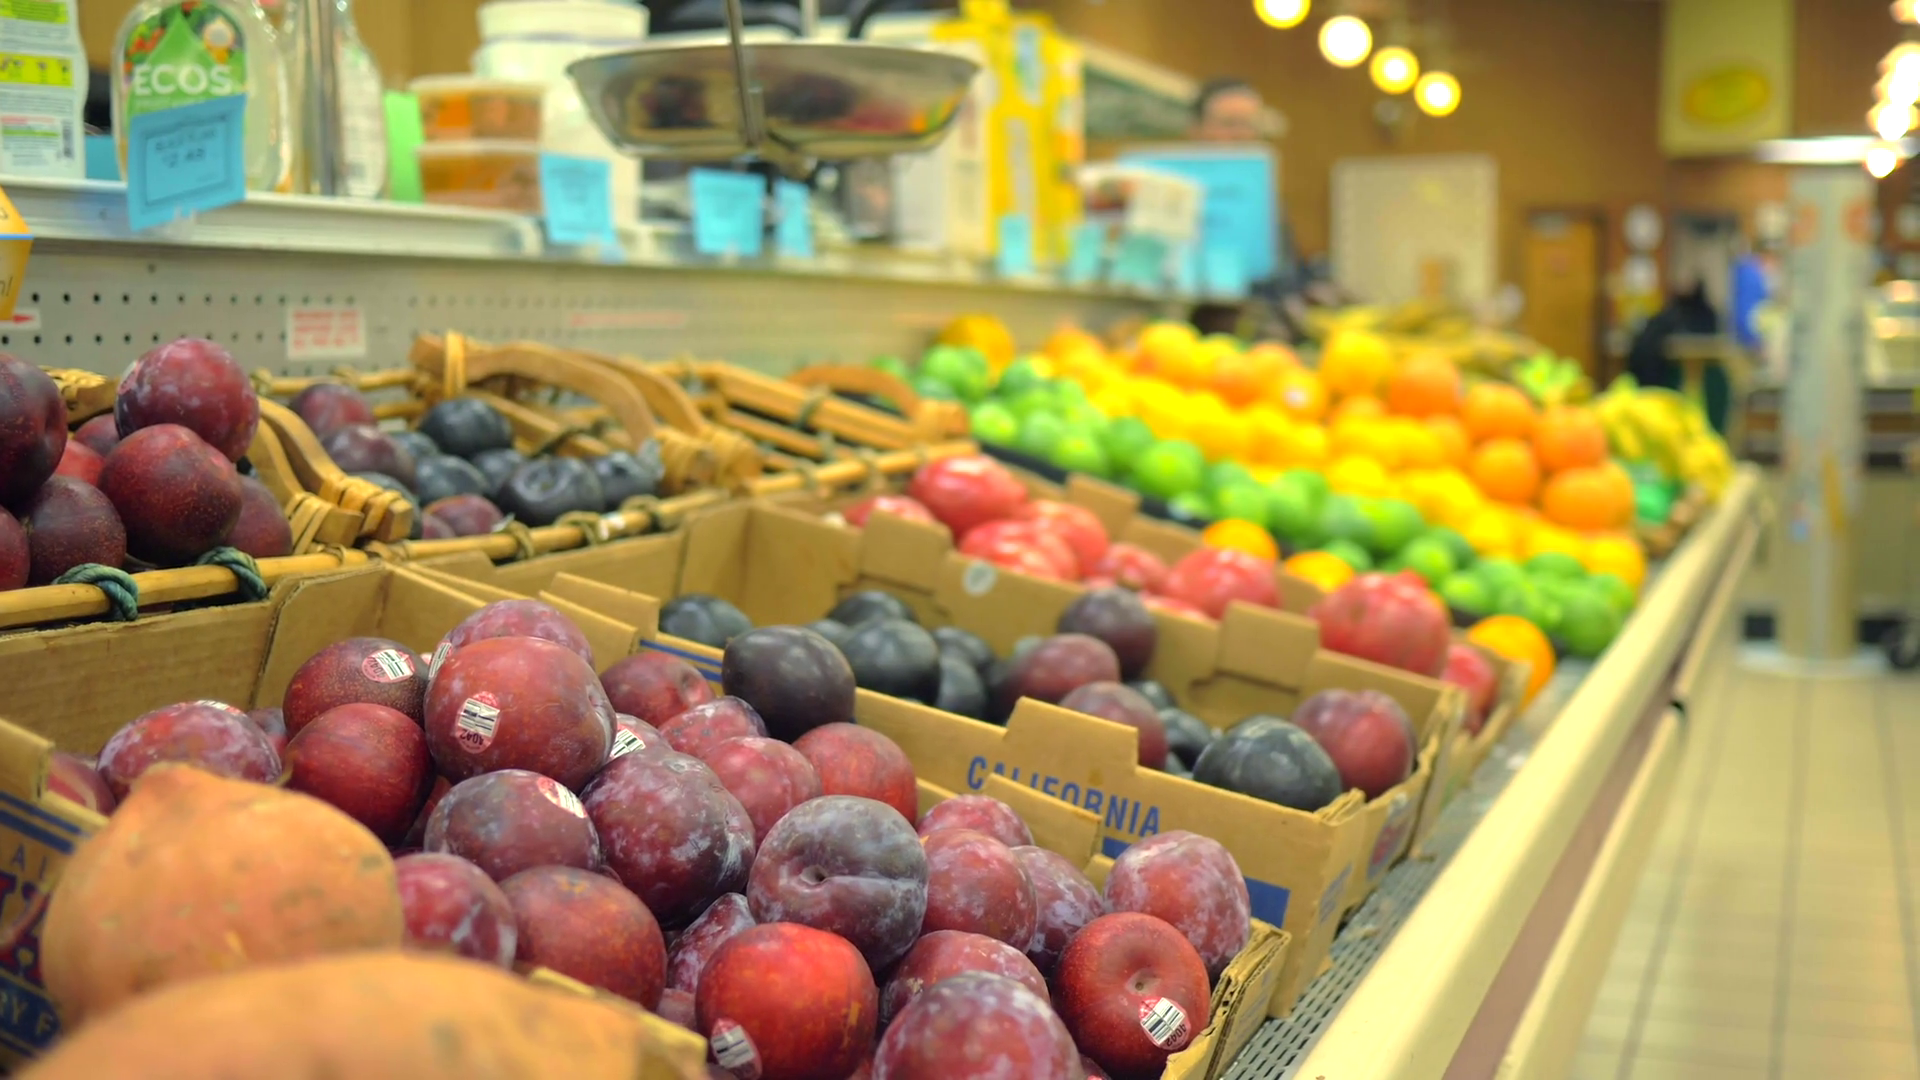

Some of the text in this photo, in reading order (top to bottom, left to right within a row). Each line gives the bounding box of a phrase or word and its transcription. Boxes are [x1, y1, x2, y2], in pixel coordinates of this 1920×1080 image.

[133, 63, 233, 95] ECOS
[460, 729, 485, 746] 4042
[1165, 1024, 1187, 1047] 4042
